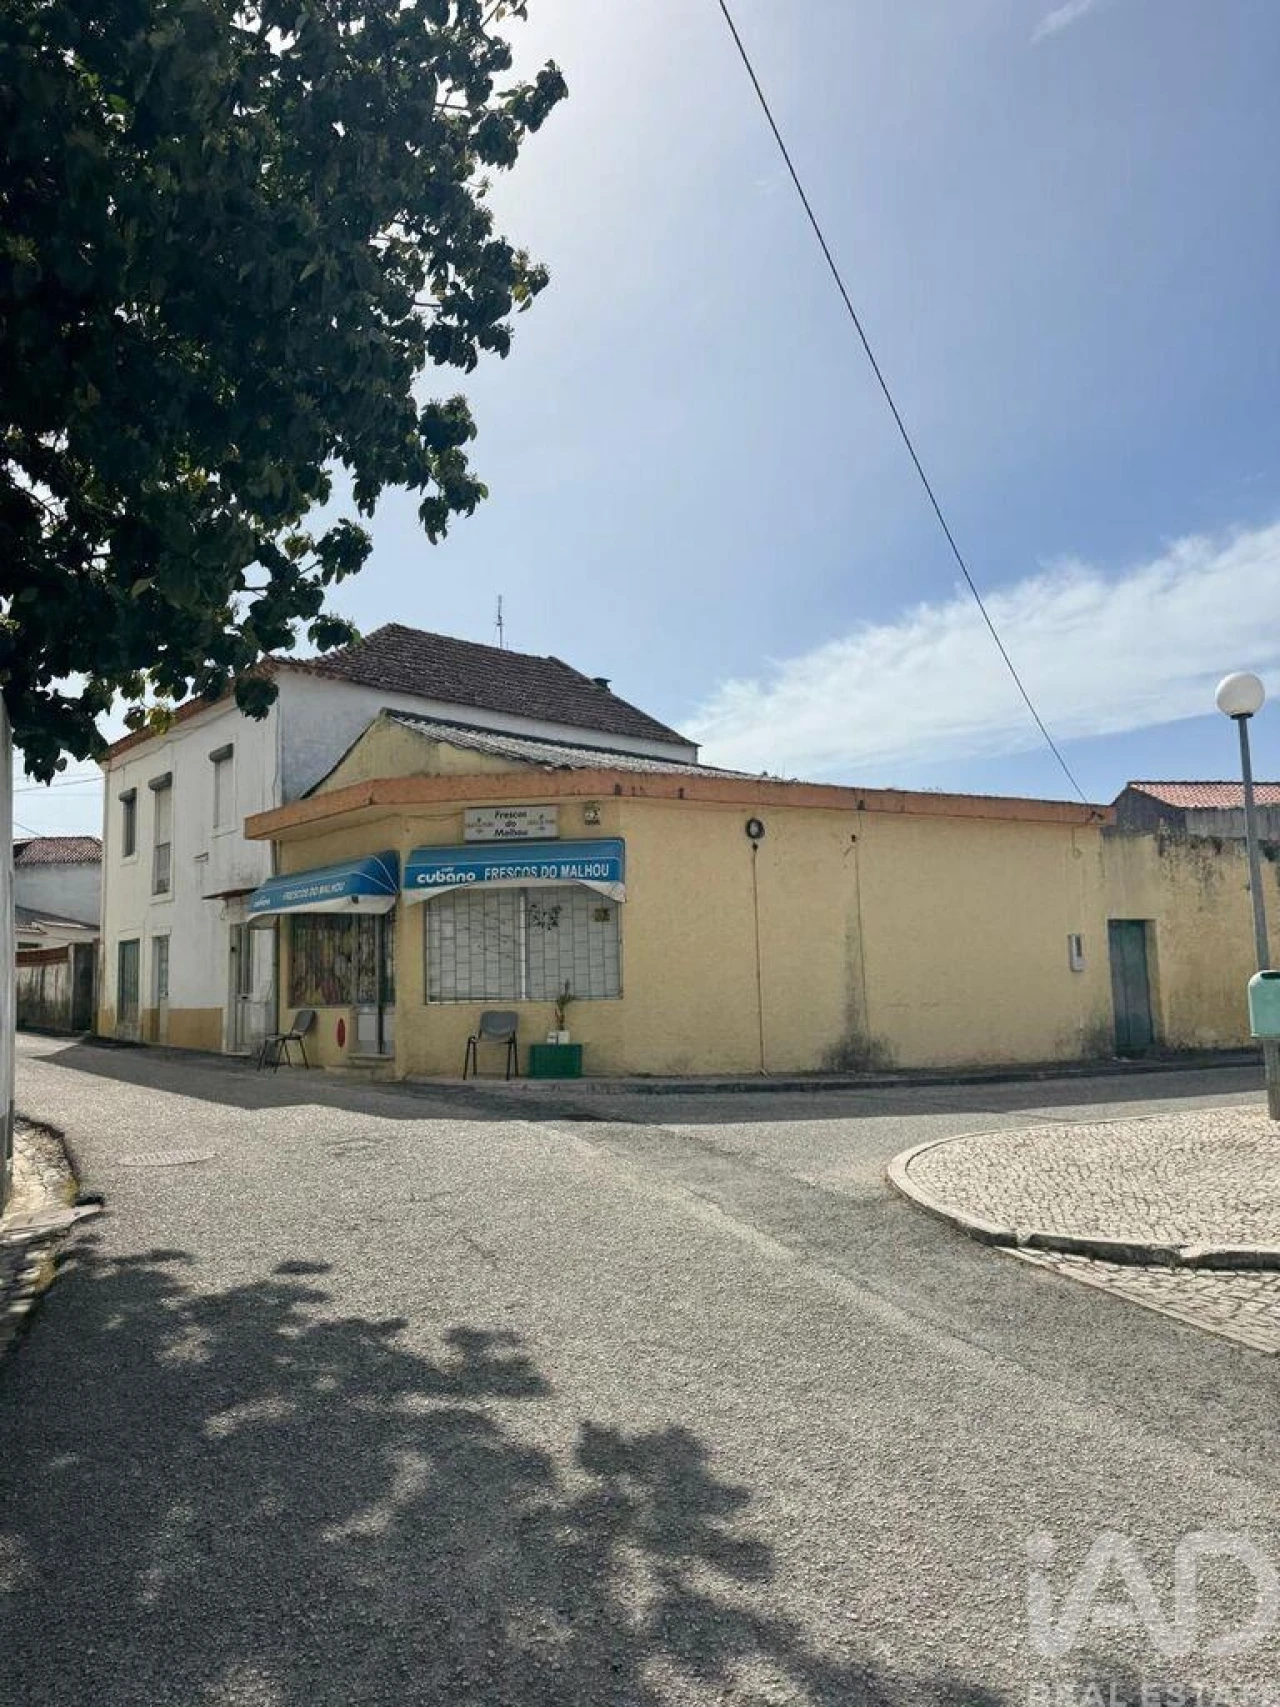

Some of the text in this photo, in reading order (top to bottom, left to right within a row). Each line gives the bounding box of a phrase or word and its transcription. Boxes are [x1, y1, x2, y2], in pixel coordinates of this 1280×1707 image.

[416, 869, 476, 885] cubano
[484, 863, 610, 881] FRESCOS DO MALHOU
